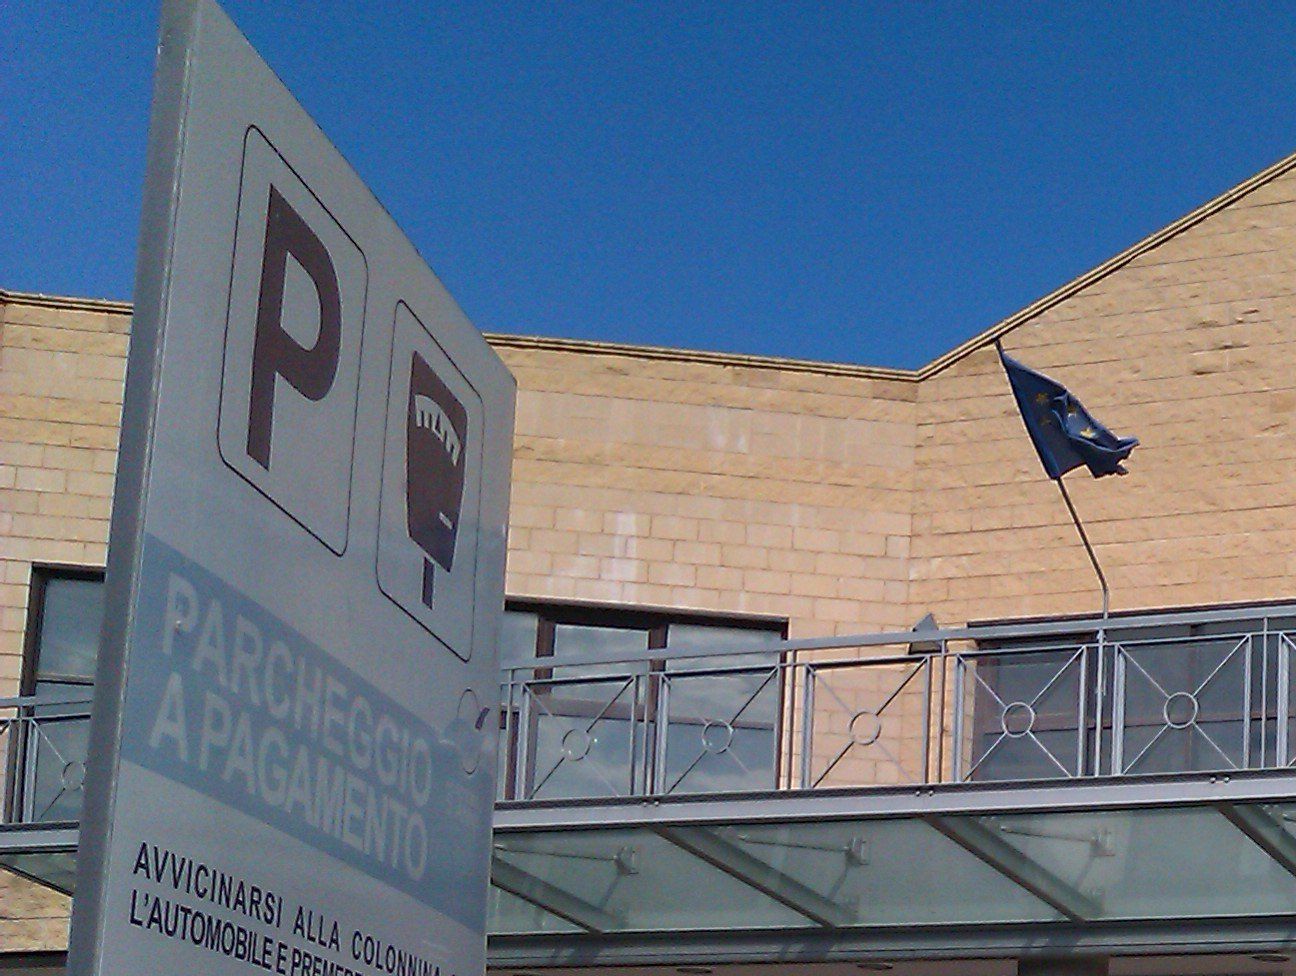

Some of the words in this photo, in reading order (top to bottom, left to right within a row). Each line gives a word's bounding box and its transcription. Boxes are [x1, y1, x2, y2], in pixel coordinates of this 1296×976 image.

[247, 183, 342, 471] P
[150, 671, 188, 763] A
[199, 690, 428, 880] PAGAMENTO
[161, 572, 432, 808] PARCHEGGIO
[130, 889, 273, 970] L'AUTOMOBILE
[276, 942, 288, 975] E
[132, 841, 283, 928] AVVICINARSI
[293, 905, 340, 951] ALLA
